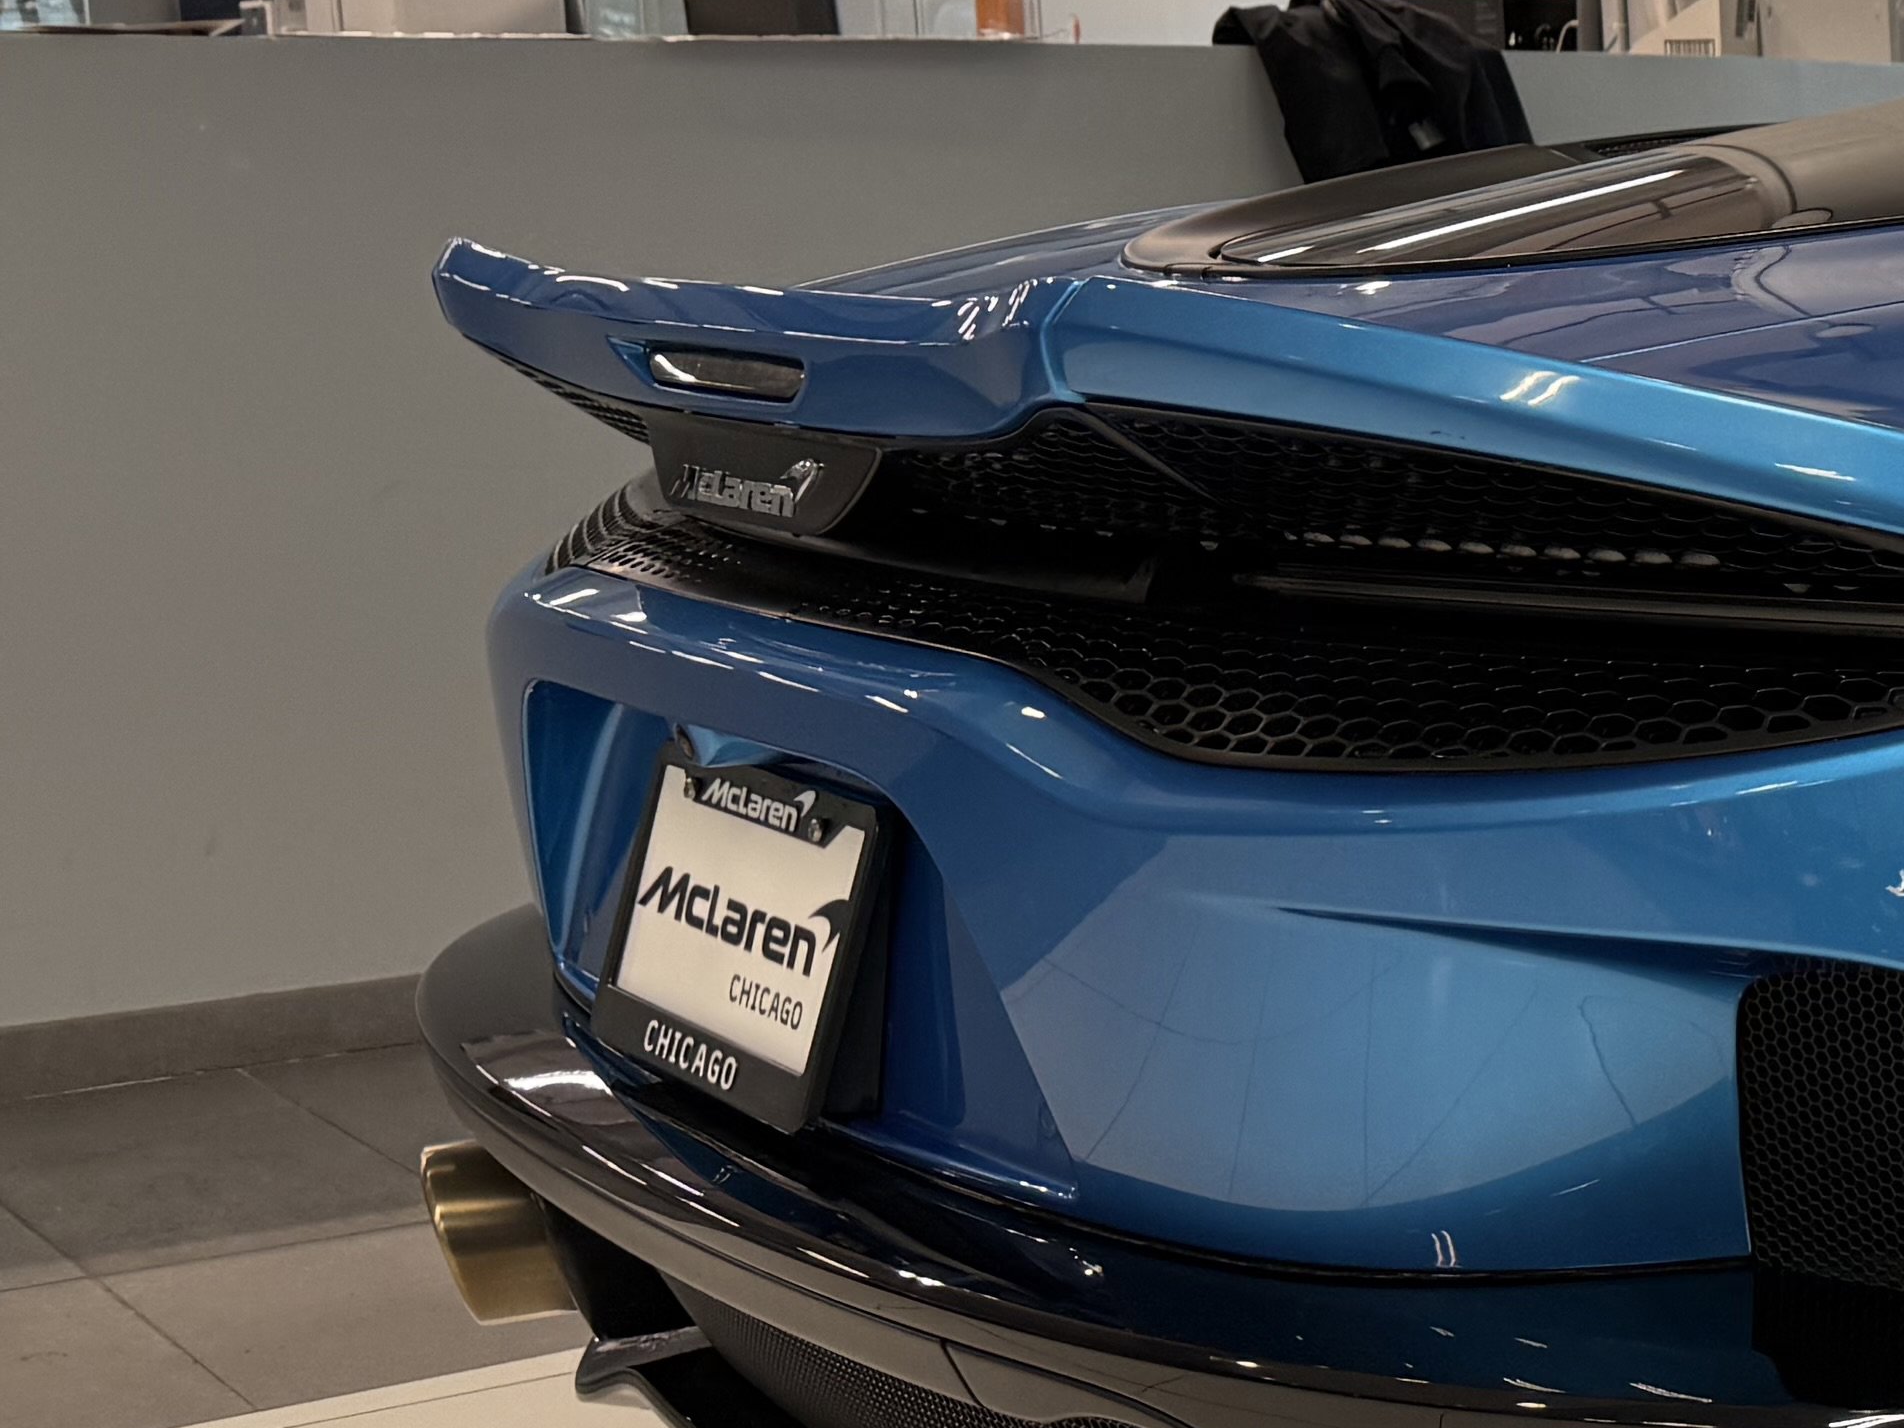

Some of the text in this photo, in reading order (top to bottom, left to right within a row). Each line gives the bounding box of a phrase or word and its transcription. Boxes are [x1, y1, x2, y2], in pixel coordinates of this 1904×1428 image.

[670, 463, 795, 518] McLaren
[702, 777, 799, 833] McLaren
[638, 865, 817, 978] McLaren
[728, 974, 804, 1032] CHICAGO
[643, 1019, 739, 1092] CHICAGO
